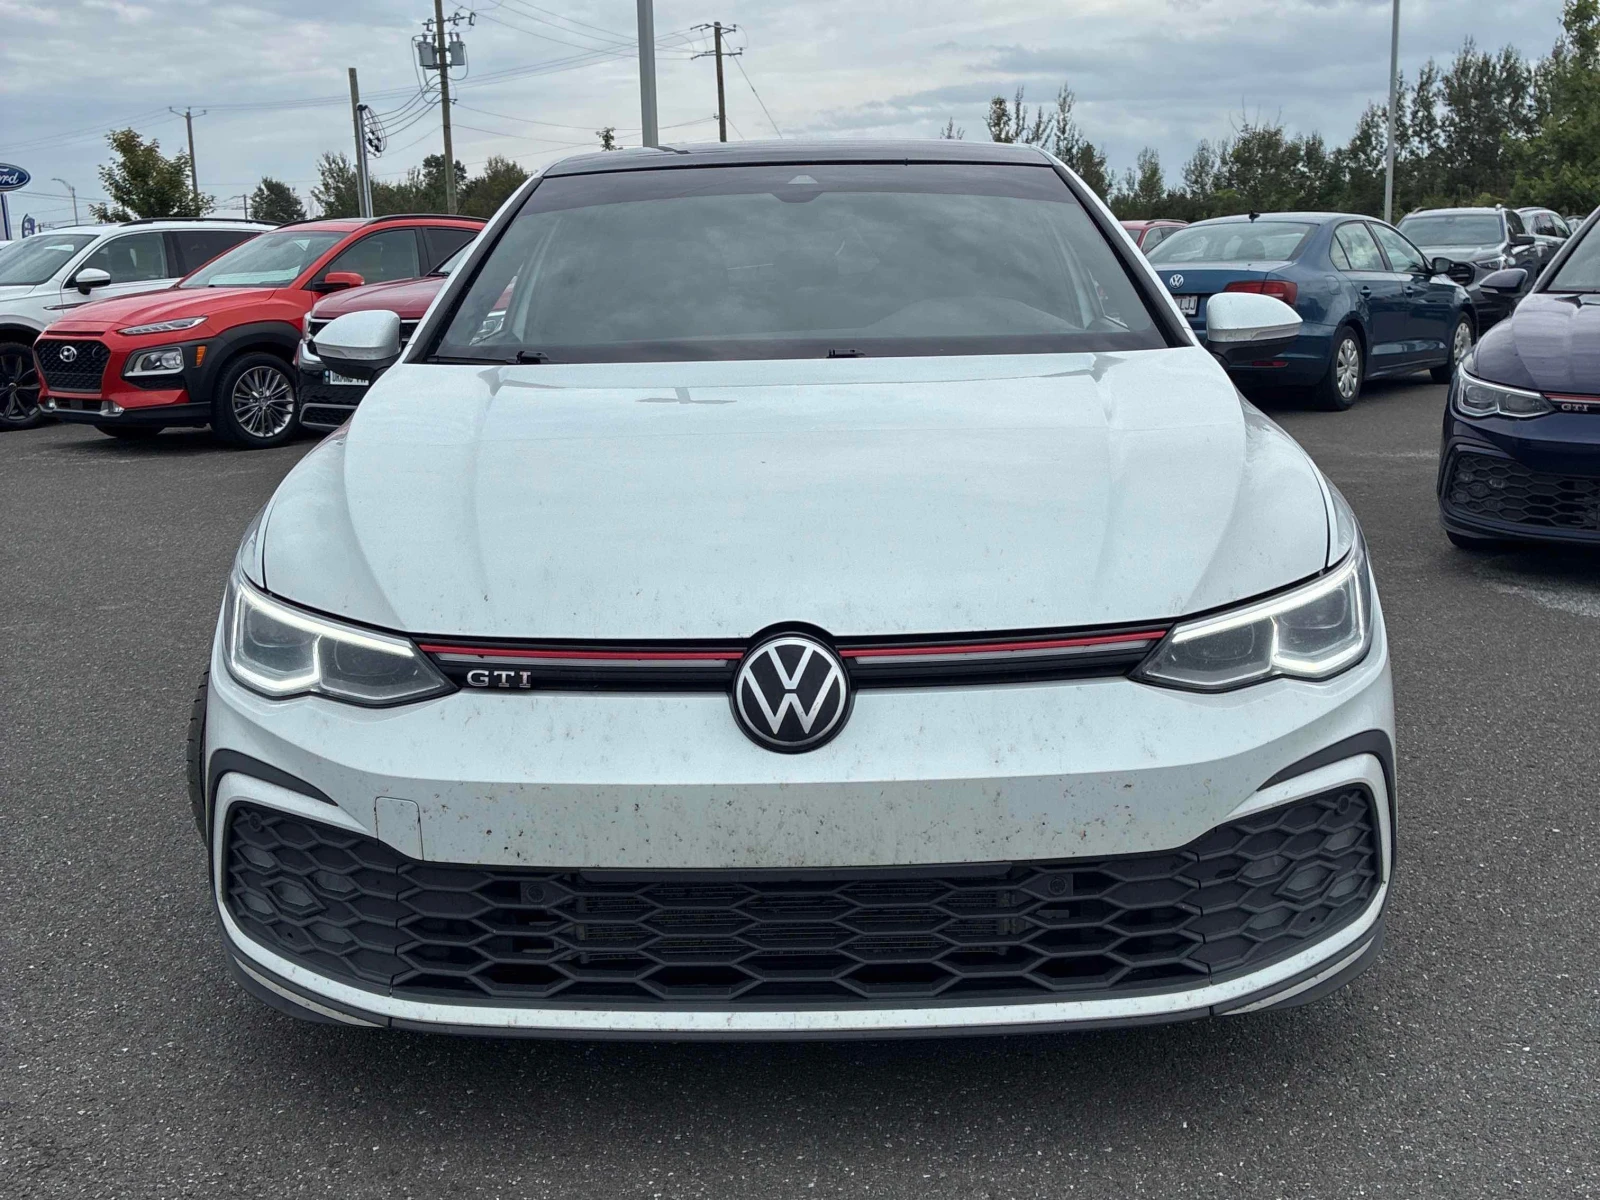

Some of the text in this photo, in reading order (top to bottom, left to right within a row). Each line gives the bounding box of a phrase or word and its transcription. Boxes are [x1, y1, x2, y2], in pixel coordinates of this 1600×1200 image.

[1561, 403, 1589, 412] GTI
[466, 669, 532, 688] GTI
[740, 640, 842, 736] VW
